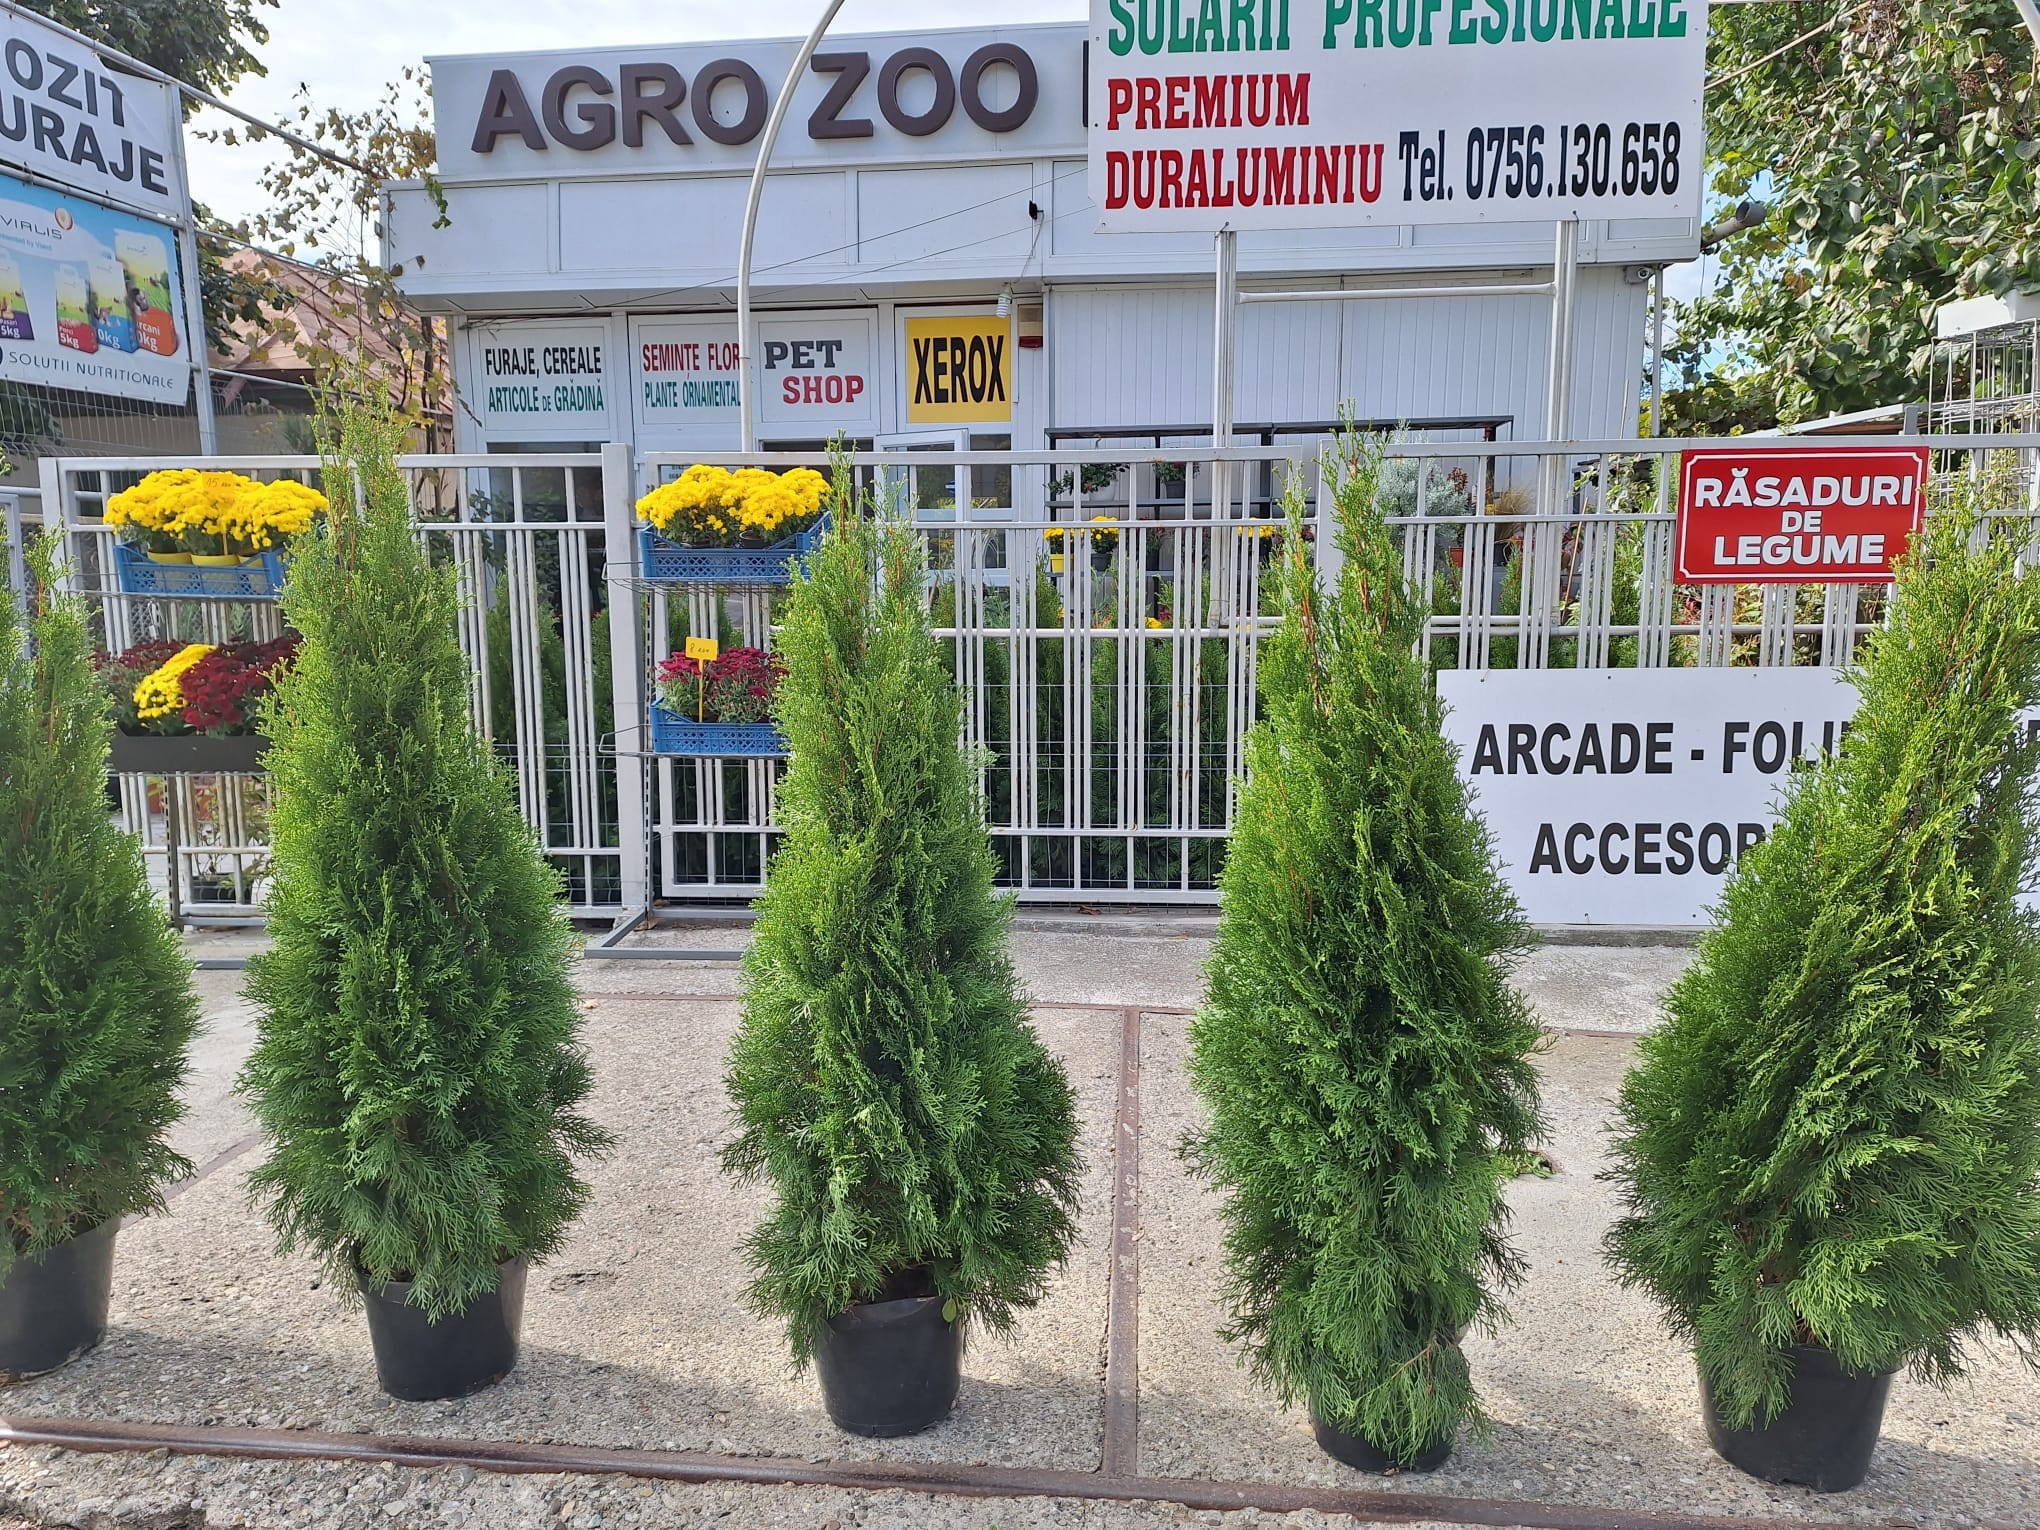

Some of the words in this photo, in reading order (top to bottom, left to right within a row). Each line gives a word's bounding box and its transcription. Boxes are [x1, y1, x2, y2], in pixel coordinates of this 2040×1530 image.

[1108, 0, 1291, 57] SOLARII
[1322, 0, 1688, 49] PROFESIONALE
[470, 57, 768, 153] AGRO
[807, 42, 1039, 140] ZOO
[1107, 72, 1311, 131] PREMIUM
[0, 88, 169, 197] URAJE
[1399, 129, 1454, 202] Tel.
[1465, 120, 1682, 201] 0756.130.658
[1104, 143, 1385, 210] DURALUMINIU
[60, 332, 80, 349] 5kg
[707, 342, 741, 372] FLOR
[763, 339, 843, 370] PET
[8, 351, 70, 373] SOLUTII
[76, 361, 174, 388] NUTRITIONALE
[485, 346, 540, 379] FURAJE,
[543, 345, 602, 375] CEREALE
[913, 334, 1006, 405] XEROX
[488, 385, 539, 413] ARTICOLE
[541, 395, 552, 412] DE
[554, 378, 605, 412] GRĂDINĂ
[645, 381, 678, 408] PLANTE
[682, 380, 741, 408] ORNAMENTAL
[782, 375, 864, 404] SHOP
[1695, 467, 1913, 507] RĂSADURI
[1781, 510, 1822, 533] DE
[1714, 534, 1885, 566] LEGUME
[1470, 721, 1674, 776] ARCADE
[1690, 749, 1705, 761] -
[1721, 720, 1852, 775] FOLI
[1528, 821, 1778, 876] ACCESOR
